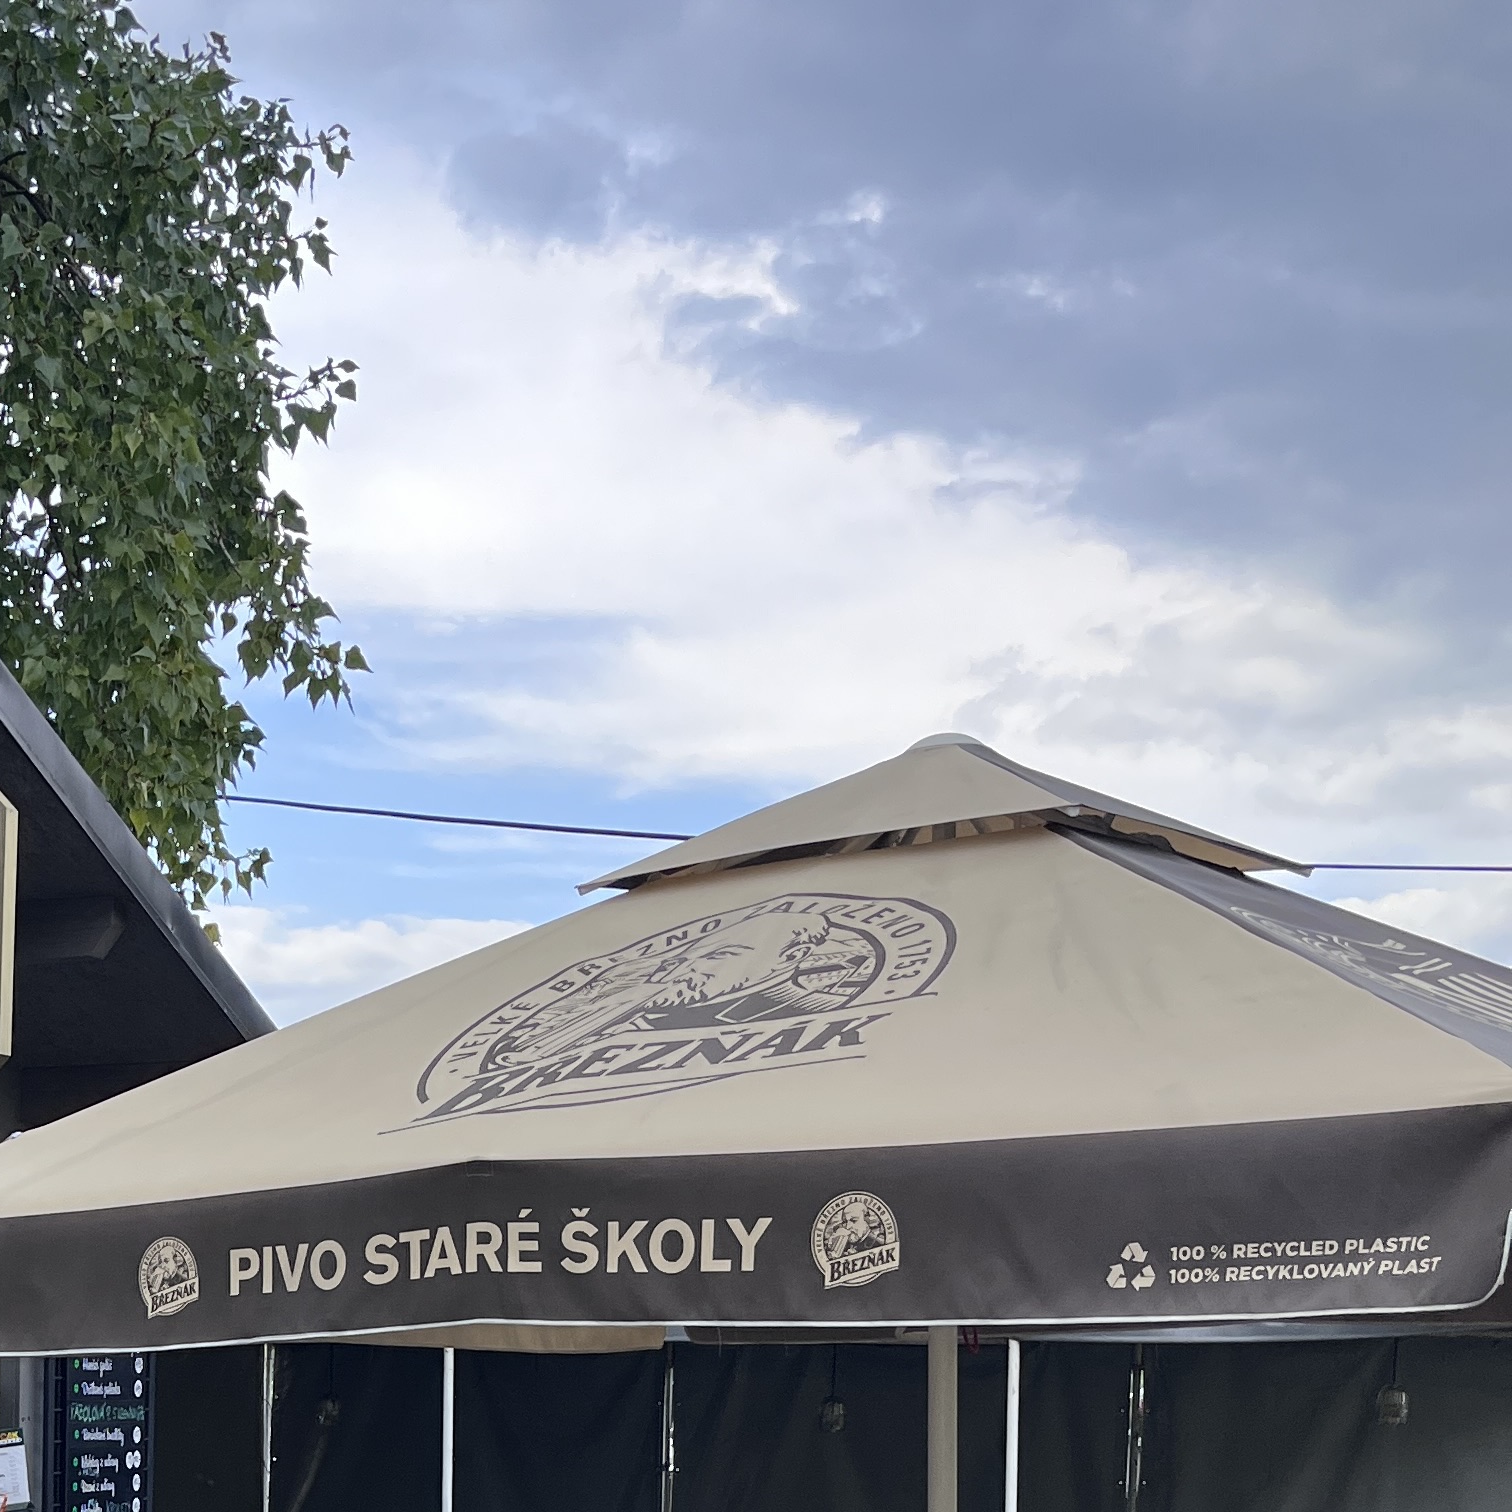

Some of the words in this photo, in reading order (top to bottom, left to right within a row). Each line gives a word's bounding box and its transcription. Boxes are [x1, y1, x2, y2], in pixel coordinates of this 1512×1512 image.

[447, 1002, 540, 1063] VELKÉ
[887, 939, 932, 981] 1753
[229, 1240, 347, 1296] PIVO
[363, 1208, 542, 1285] STARÉ
[560, 1207, 773, 1274] ŠKOLY
[1169, 1267, 1219, 1284] 100%
[1225, 1258, 1374, 1282] RECYKLOVANÝ
[1378, 1257, 1441, 1275] PLAST
[1170, 1246, 1205, 1261] 100
[1210, 1244, 1226, 1260] %
[1232, 1240, 1338, 1259] RECYCLED
[1344, 1235, 1430, 1254] PLASTIC
